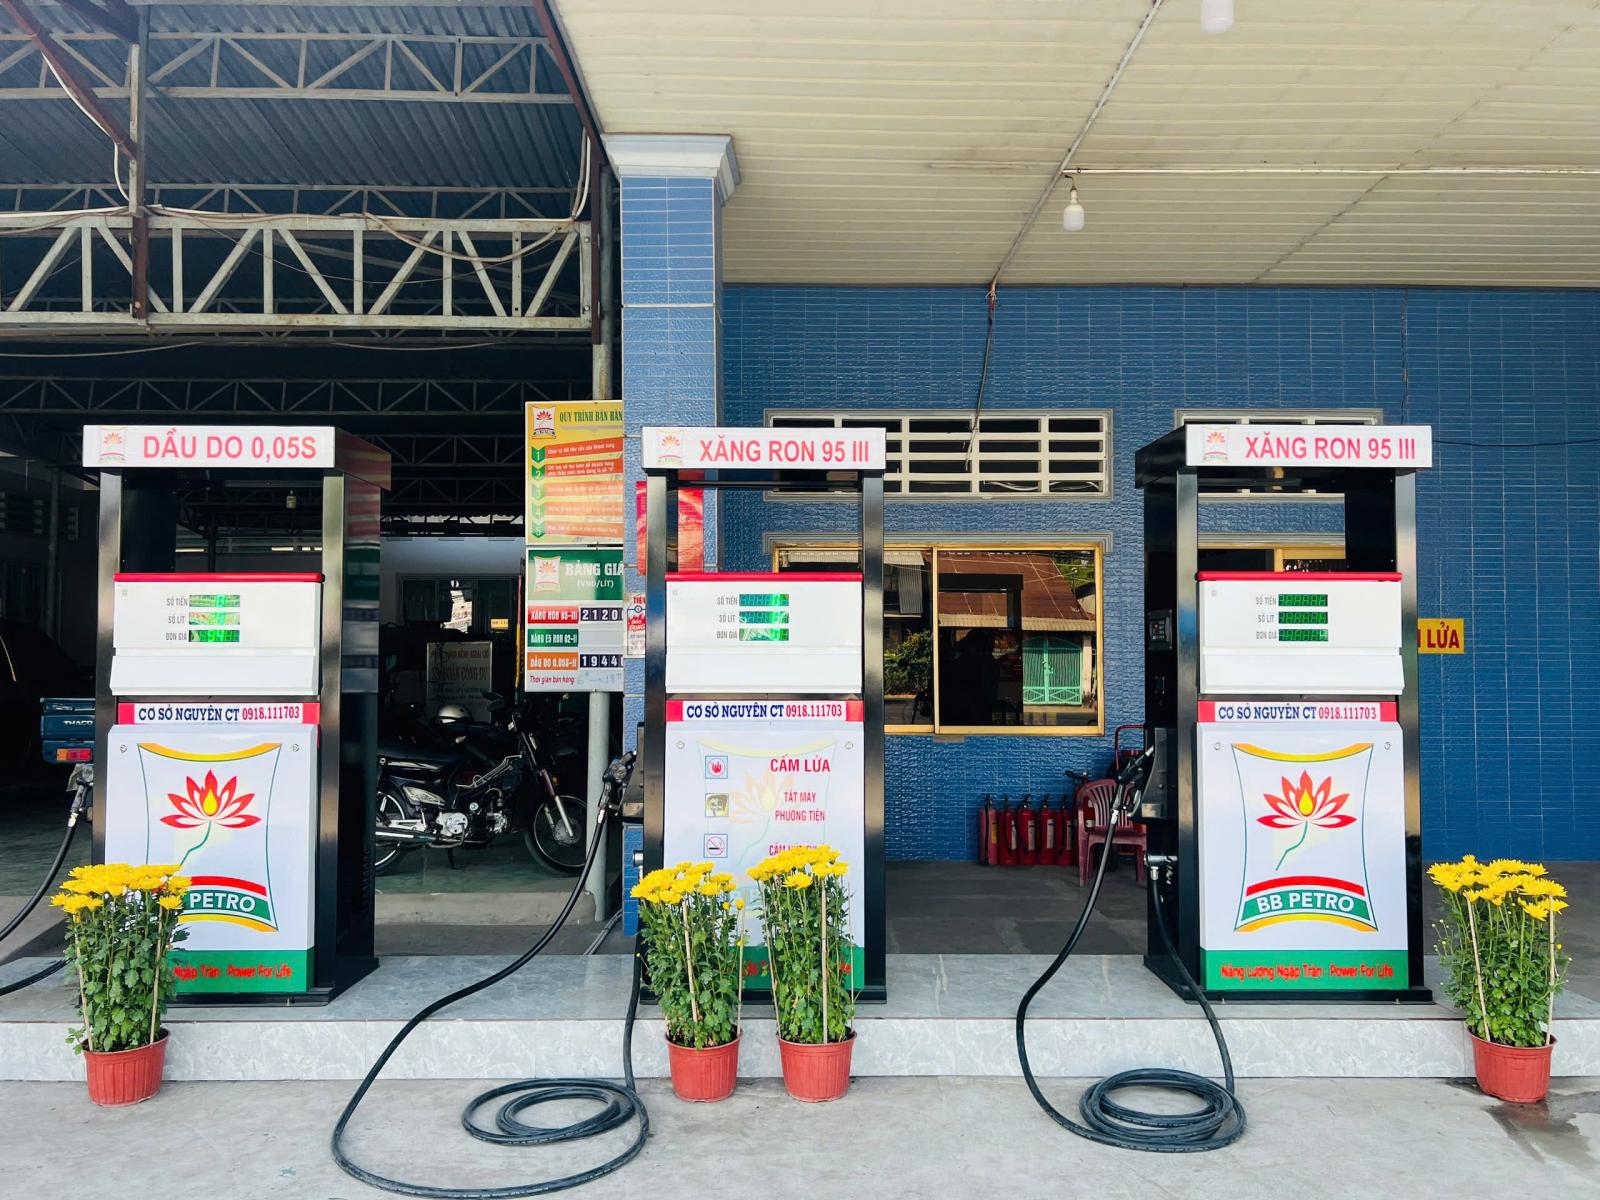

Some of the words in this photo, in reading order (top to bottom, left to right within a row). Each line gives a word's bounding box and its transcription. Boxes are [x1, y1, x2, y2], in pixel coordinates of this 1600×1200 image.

[143, 428, 196, 459] DẦU
[206, 435, 244, 459] DO
[251, 435, 317, 463] 0,05S
[699, 434, 761, 462] XĂNG
[768, 440, 814, 462] RON
[822, 440, 846, 462] 95
[852, 440, 869, 462] III
[1245, 432, 1306, 460] XĂNG
[1314, 437, 1361, 460] RON
[1368, 437, 1392, 460] 95
[1399, 438, 1416, 460] III
[565, 560, 600, 576] BẢNG
[1426, 621, 1460, 648] LỬA
[138, 706, 155, 721] CƠ
[158, 704, 173, 721] SỞ
[175, 704, 222, 721] NGUYÊN
[225, 707, 240, 721] CT
[242, 706, 300, 720] 0918.111703
[686, 705, 702, 718] CƠ
[705, 702, 719, 718] SỞ
[722, 702, 768, 718] NGUYÊN
[770, 704, 784, 718] CT
[786, 704, 842, 718] 0918.111703
[1218, 706, 1234, 720] CƠ
[1237, 702, 1251, 720] SỞ
[1254, 703, 1300, 720] NGUYÊN
[1302, 706, 1317, 720] CT
[1318, 706, 1377, 720] 0918.111703
[770, 754, 800, 772] CẤM
[804, 755, 830, 772] LỬA
[190, 892, 256, 913] PETRO
[1256, 893, 1283, 913] BB
[1288, 892, 1354, 912] PETRO
[227, 964, 256, 978] Power
[258, 964, 273, 978] For
[274, 964, 292, 978] Life
[1330, 964, 1358, 978] Power
[1360, 964, 1375, 978] For
[1377, 963, 1394, 978] Life
